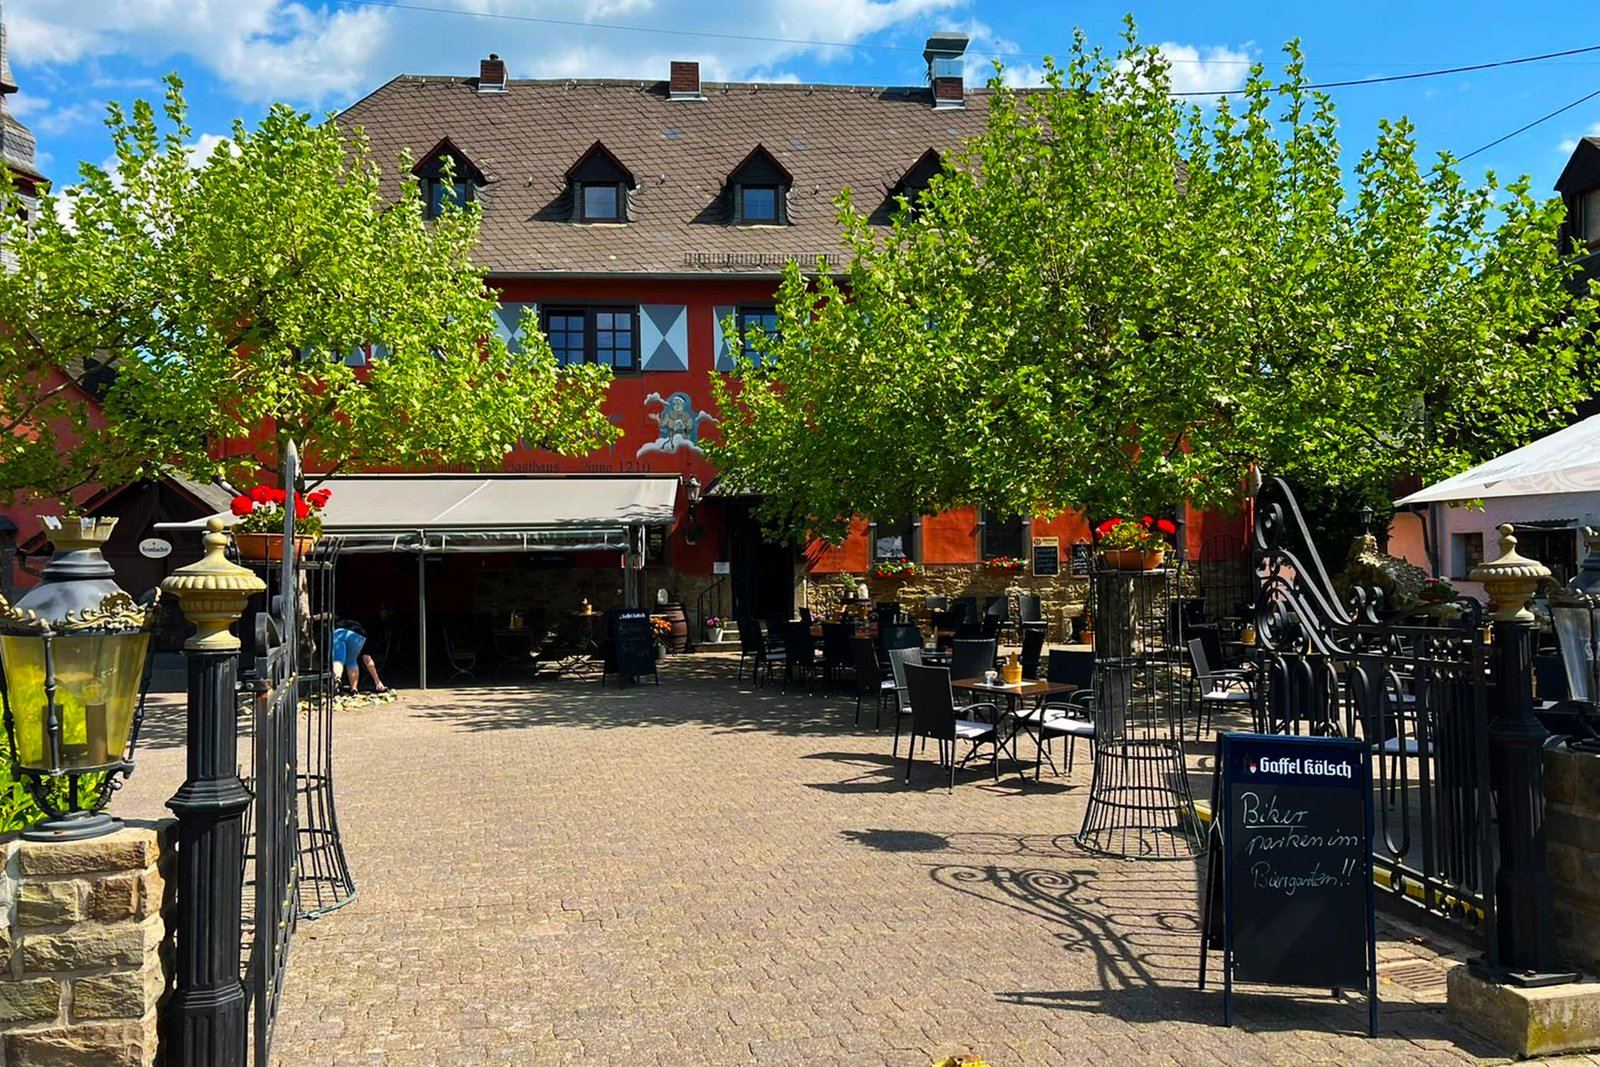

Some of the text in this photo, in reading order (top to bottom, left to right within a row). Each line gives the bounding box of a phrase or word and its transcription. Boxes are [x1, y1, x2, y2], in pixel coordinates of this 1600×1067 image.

[619, 461, 651, 473] 1210
[1260, 757, 1352, 778] Gaffel Kölsch
[1241, 792, 1308, 824] Biker
[1245, 827, 1358, 855] parken im
